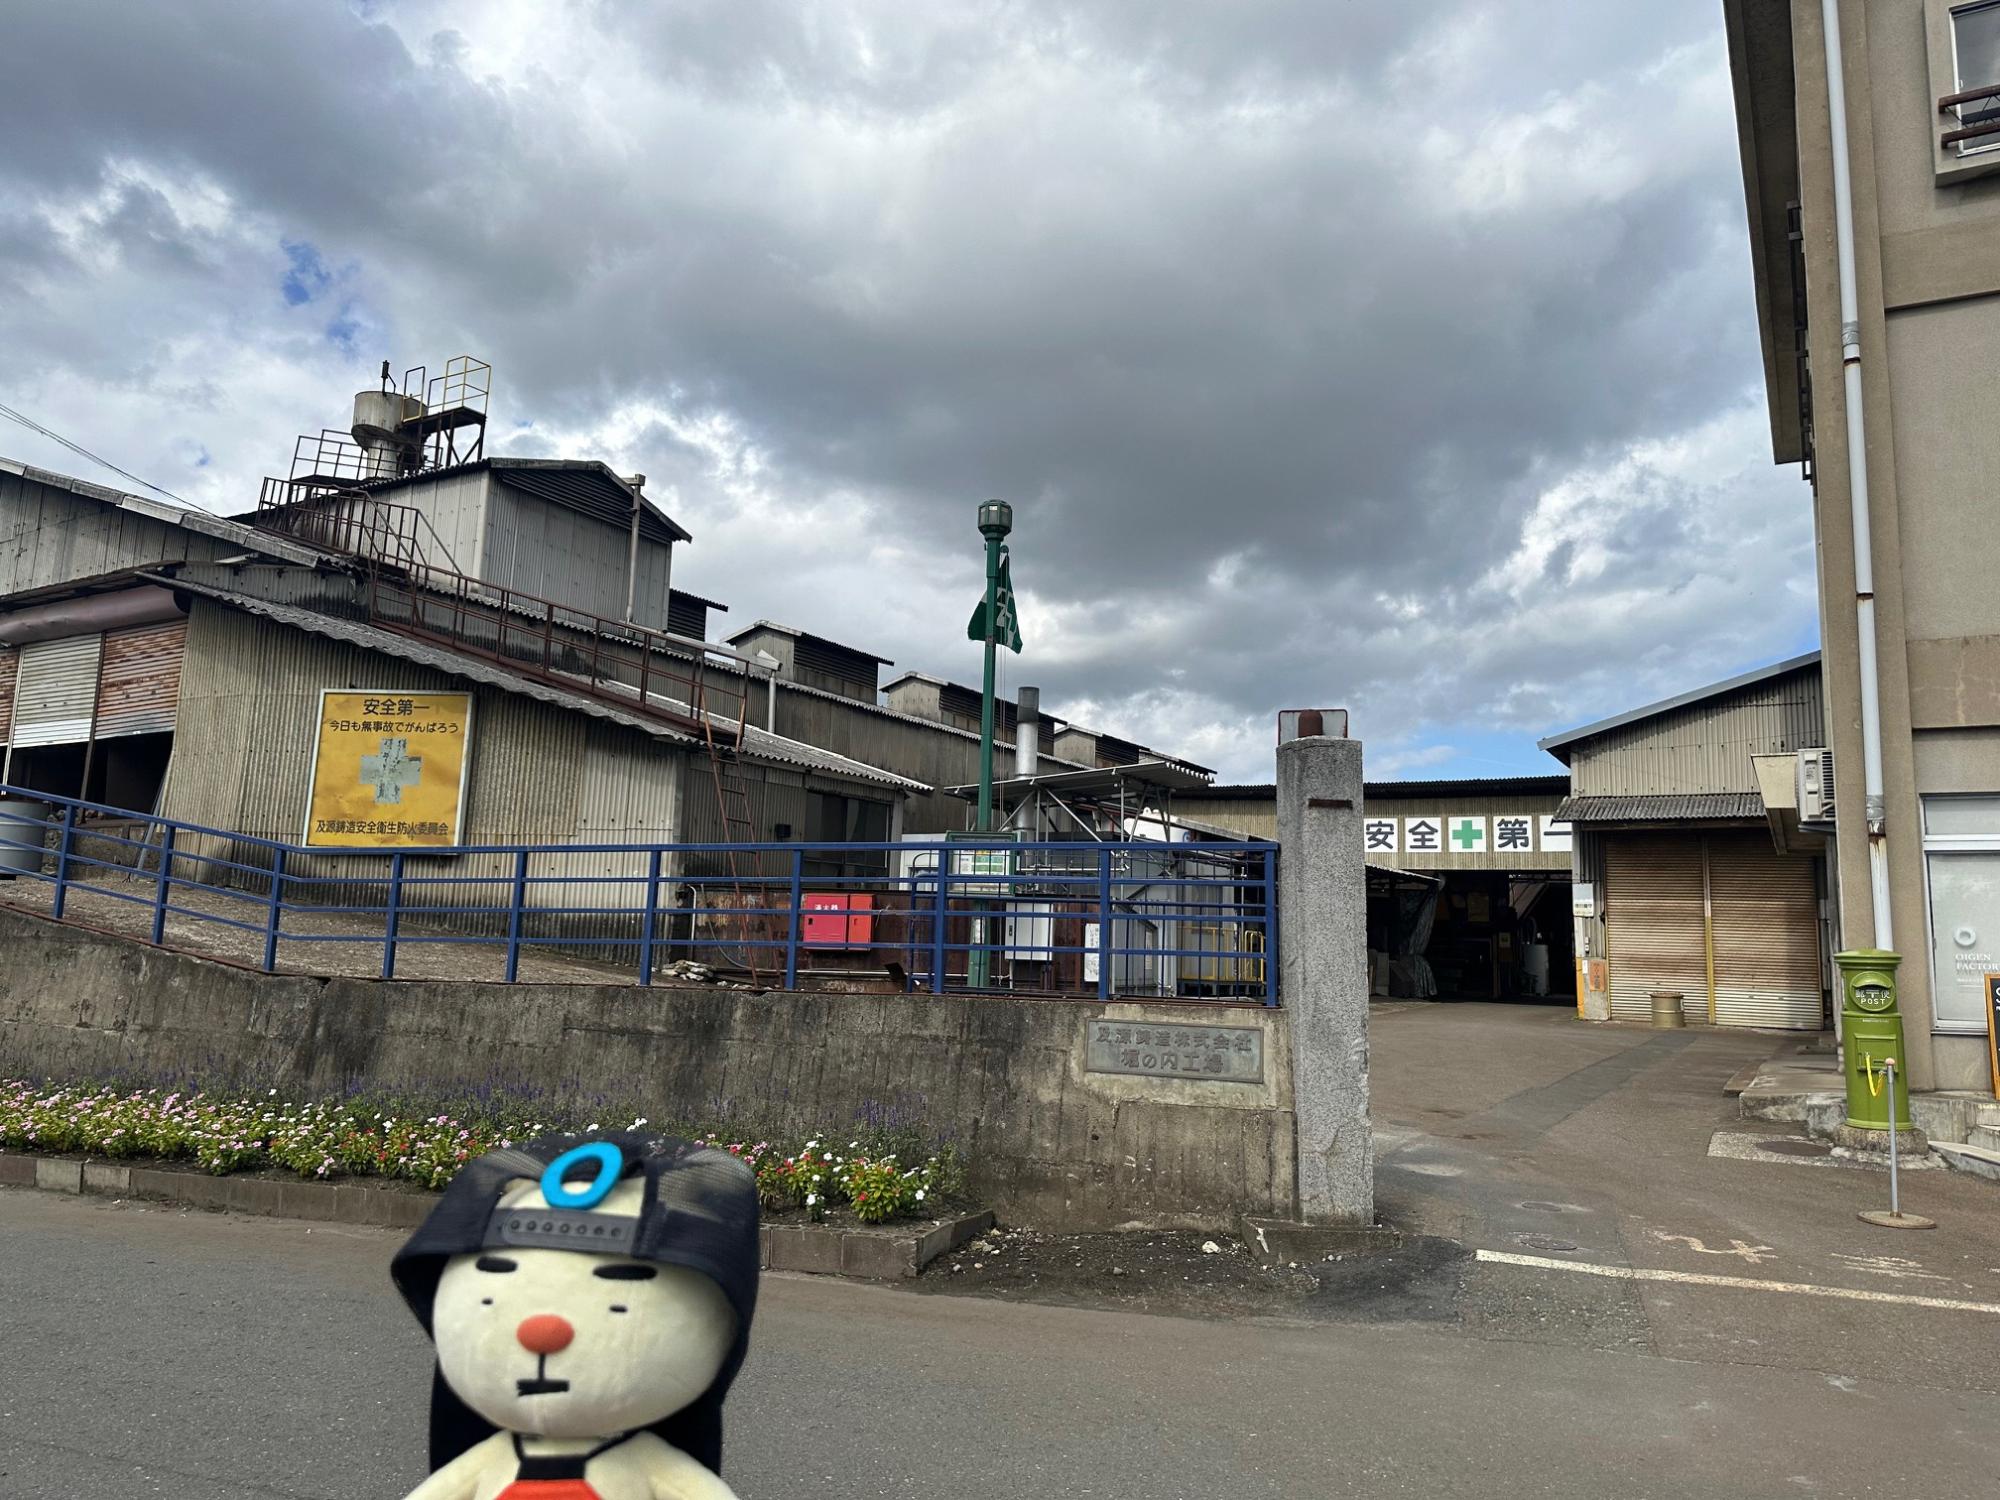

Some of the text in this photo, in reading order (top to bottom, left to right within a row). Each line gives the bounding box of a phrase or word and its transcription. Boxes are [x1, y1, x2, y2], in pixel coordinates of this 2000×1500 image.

[362, 698, 430, 716] 安全第一
[329, 720, 459, 734] 今日も無事故でがんばろう
[1955, 952, 1991, 961] OIGEN
[1956, 962, 2000, 971] FACTOR
